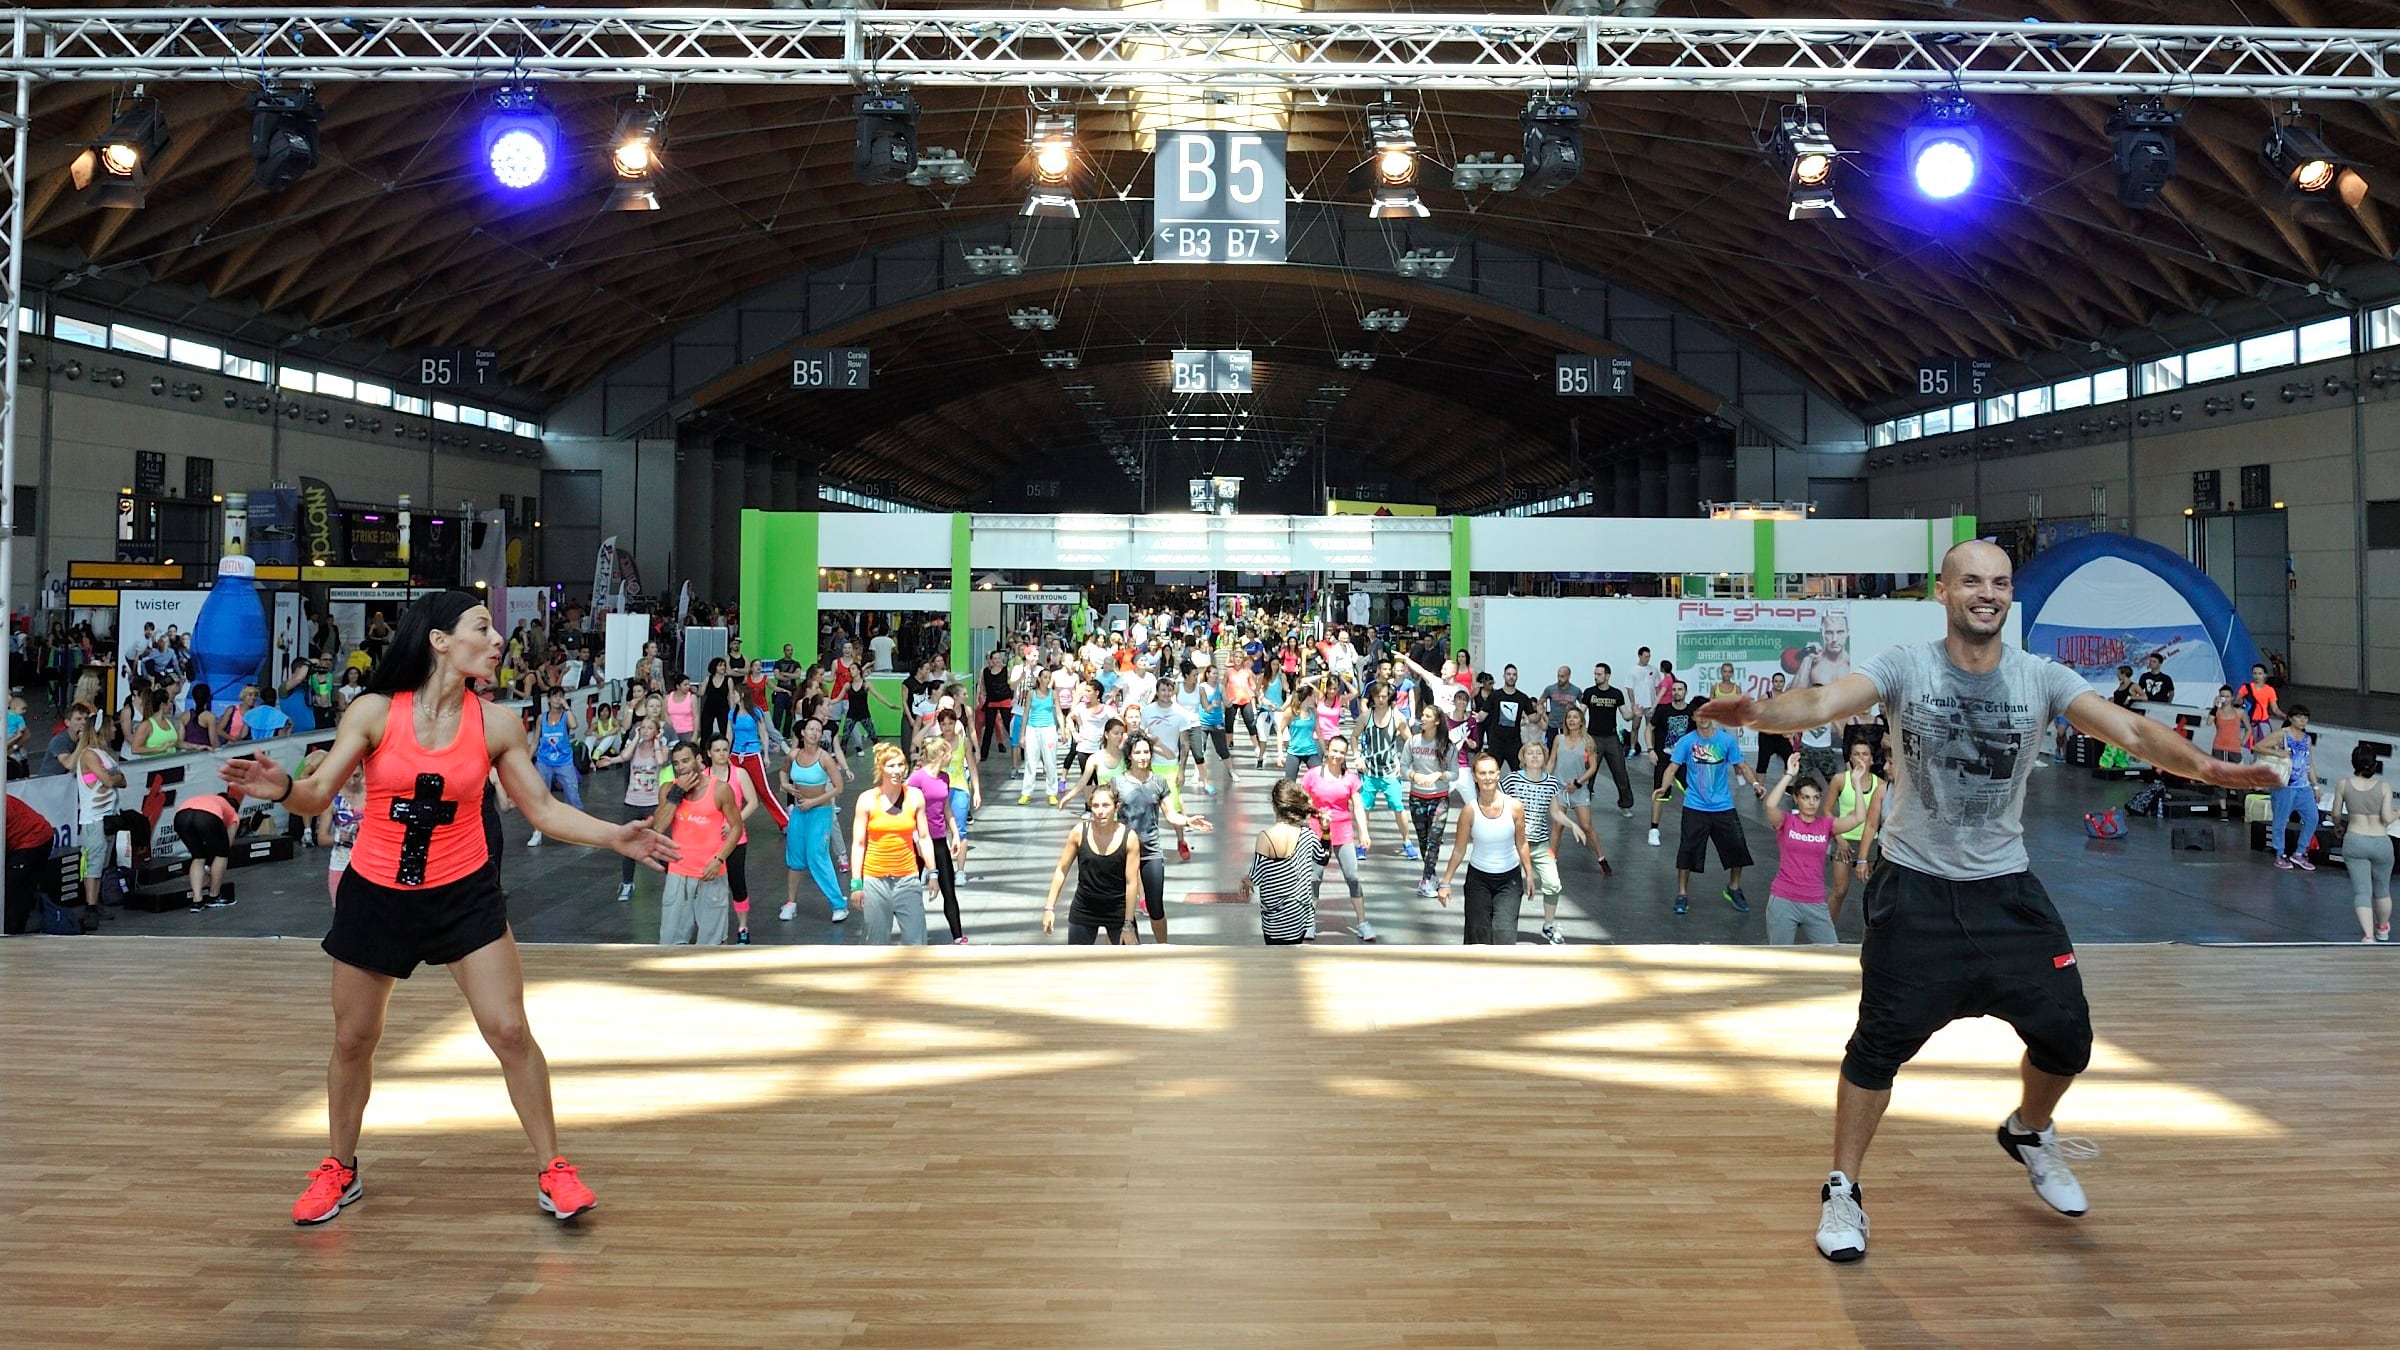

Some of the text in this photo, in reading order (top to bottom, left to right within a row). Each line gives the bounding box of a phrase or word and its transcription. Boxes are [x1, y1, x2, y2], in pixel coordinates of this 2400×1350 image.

[1179, 134, 1264, 204] B5
[1178, 227, 1260, 257] B3 B7
[475, 350, 496, 358] Corsia
[847, 351, 868, 359] Corsia
[475, 359, 490, 367] Row
[847, 360, 862, 368] Row
[1229, 364, 1245, 372] Row
[1611, 359, 1632, 367] Corsia
[1972, 361, 1992, 369] Corsia
[421, 358, 452, 385] B5
[477, 367, 484, 385] 1
[793, 359, 823, 386] B5
[847, 369, 857, 386] 2
[1175, 363, 1206, 390] B5
[1611, 367, 1626, 375] Row
[1972, 369, 1987, 377] Row
[1230, 373, 1239, 390] 3
[1559, 367, 1588, 393] B5
[1612, 376, 1623, 393] 4
[1919, 368, 1949, 395] B5
[1973, 378, 1982, 395] 5
[865, 484, 880, 496] D5
[1026, 484, 1041, 497] D5
[1190, 485, 1206, 498] D5
[1513, 487, 1528, 500] D5
[135, 598, 181, 610] twister
[1409, 595, 1449, 607] T-SHIRT
[1678, 602, 1817, 623] Fit-shop
[1679, 634, 1782, 648] functional training
[2055, 634, 2127, 666] LAURETANA
[1921, 693, 1957, 708] Herald
[152, 845, 174, 857] FITNESS
